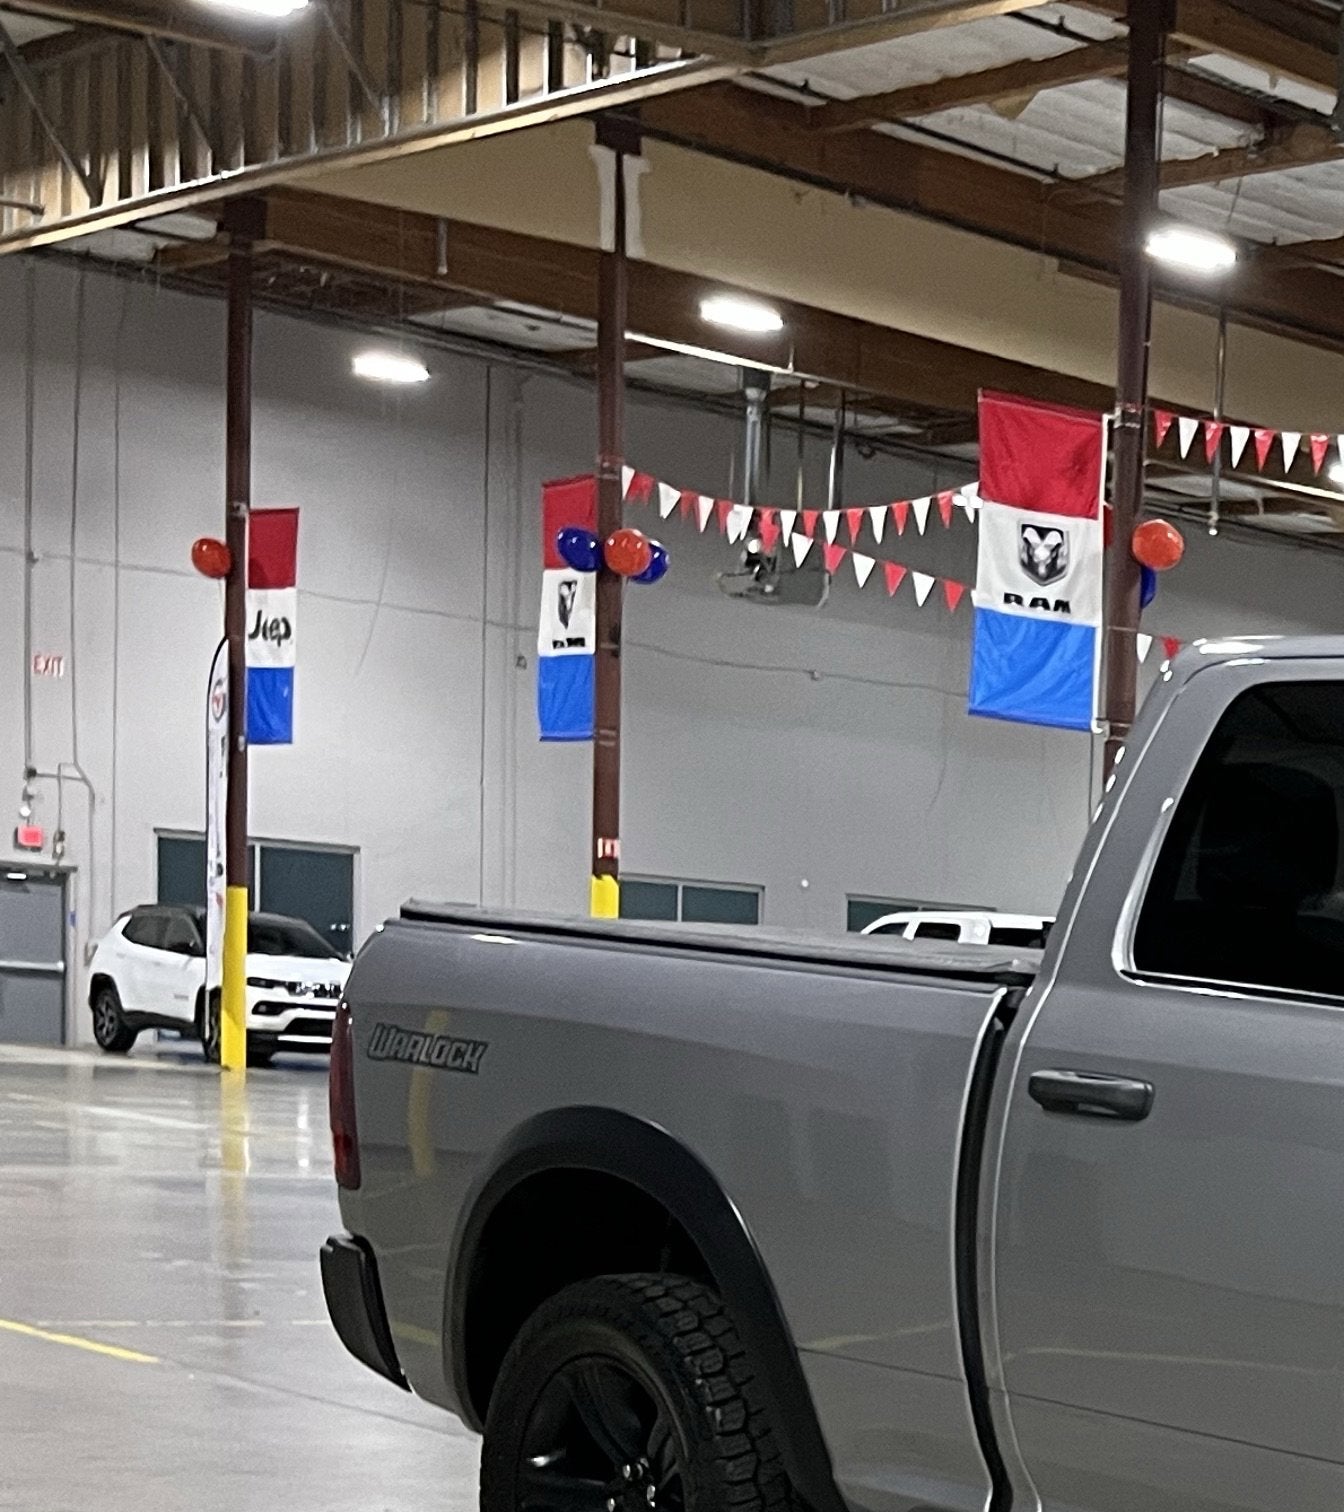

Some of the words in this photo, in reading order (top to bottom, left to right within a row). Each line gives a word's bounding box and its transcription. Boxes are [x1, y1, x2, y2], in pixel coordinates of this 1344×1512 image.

[1003, 592, 1071, 614] RAM
[248, 609, 292, 647] Jeep
[33, 654, 64, 677] EXIT
[367, 1022, 488, 1075] WARLOCK
